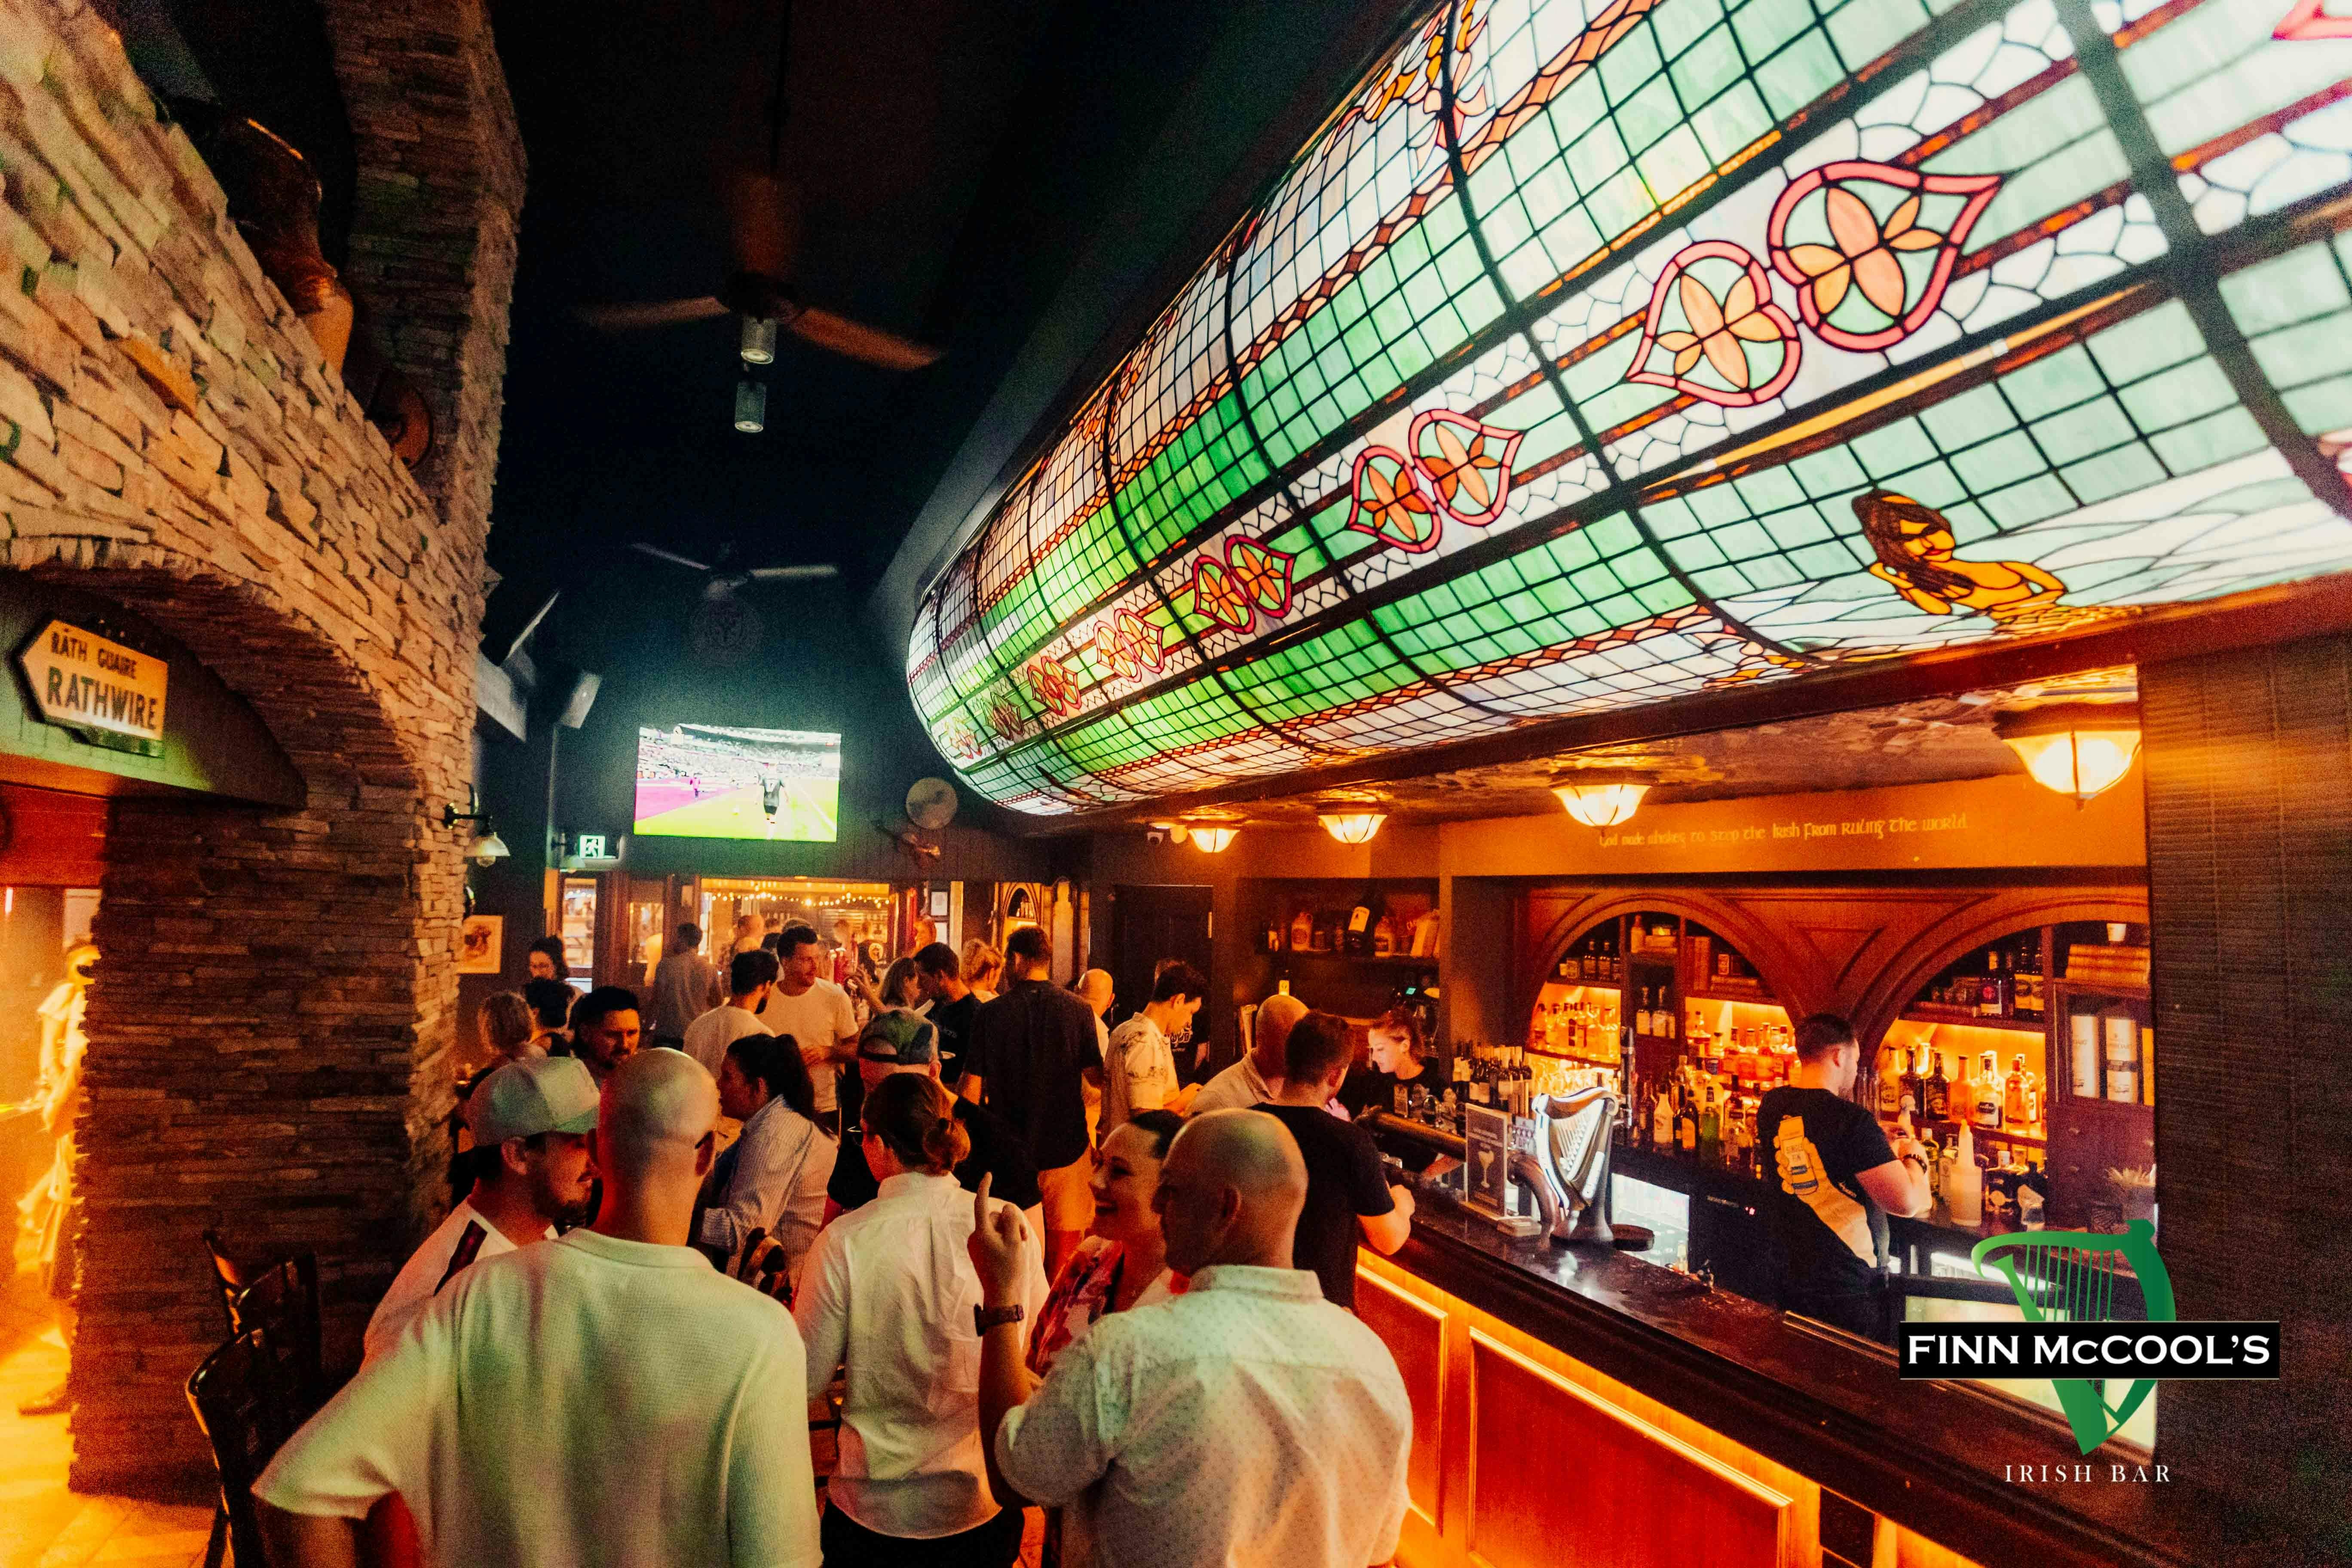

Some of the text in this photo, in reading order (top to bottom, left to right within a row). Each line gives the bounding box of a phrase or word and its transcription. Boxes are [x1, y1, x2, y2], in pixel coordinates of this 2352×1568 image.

[47, 666, 158, 729] RATHWIRE
[1743, 826, 1765, 840] the
[1773, 822, 1800, 839] Irish
